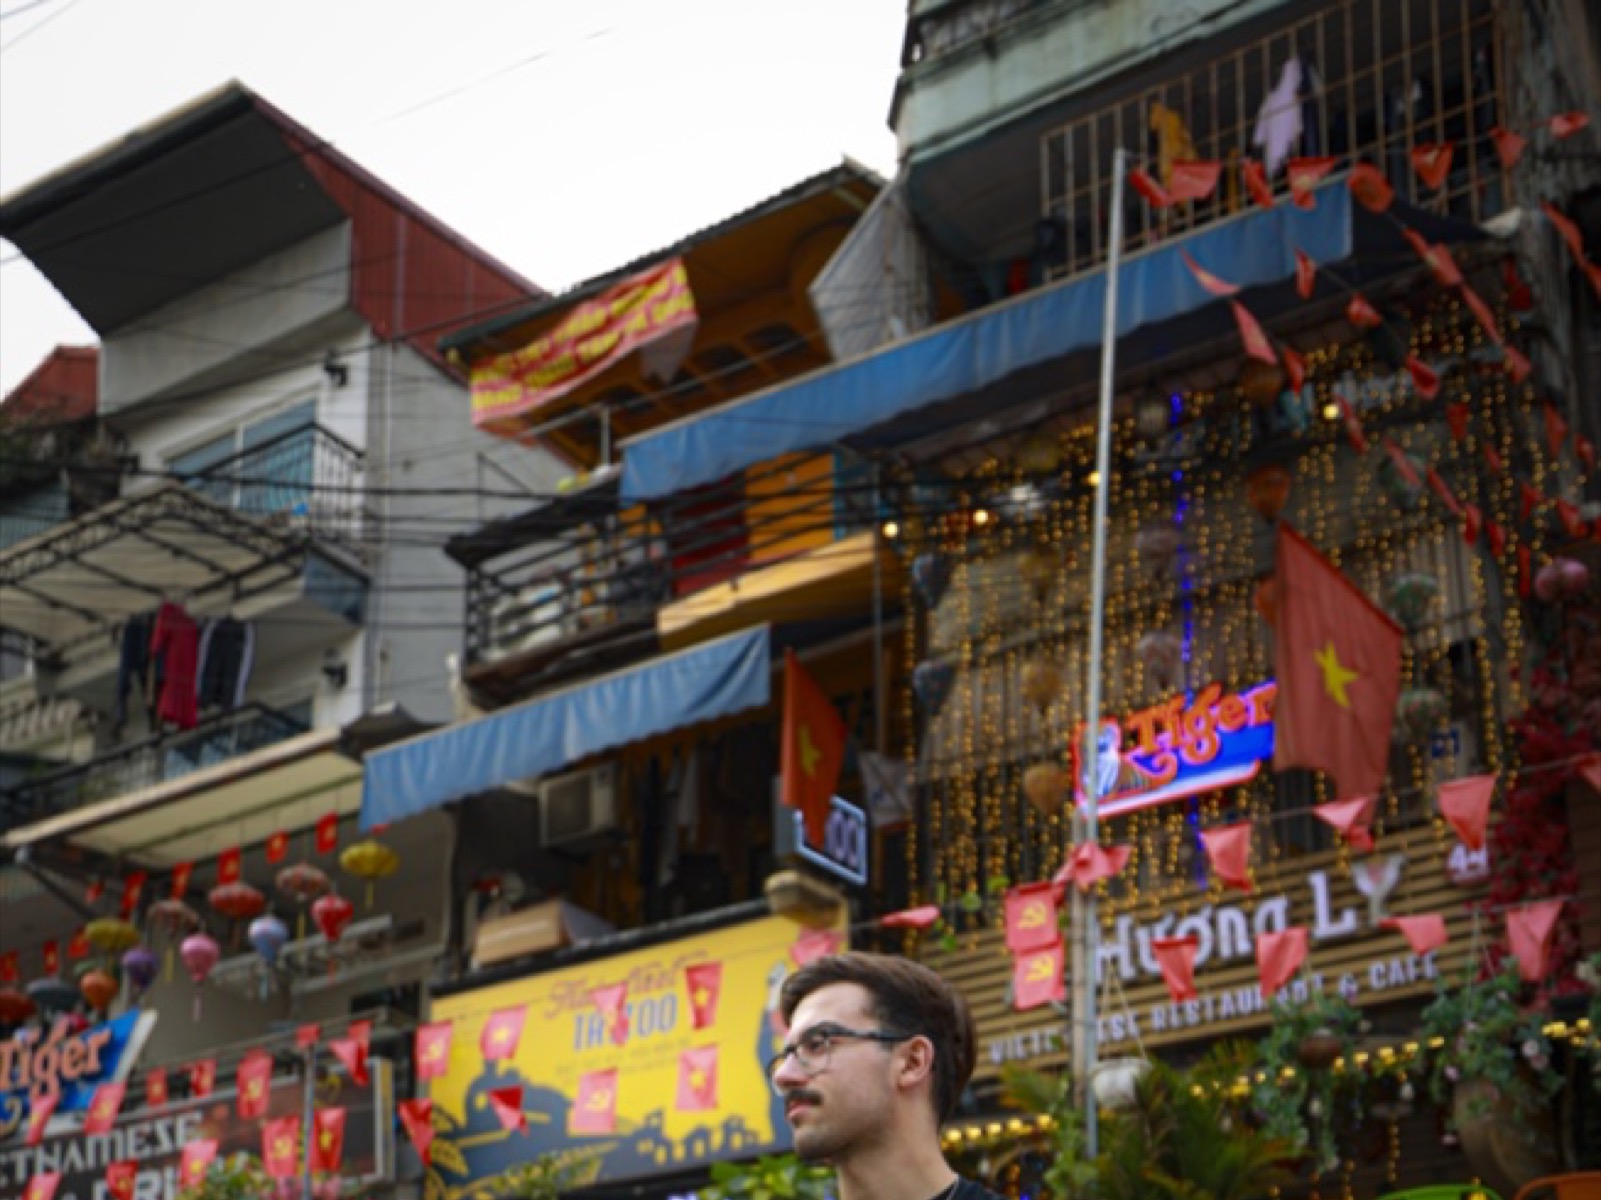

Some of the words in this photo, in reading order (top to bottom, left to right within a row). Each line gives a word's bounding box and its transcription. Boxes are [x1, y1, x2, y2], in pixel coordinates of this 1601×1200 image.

[1126, 682, 1278, 764] Tiger
[1307, 853, 1406, 939] LY
[0, 1018, 112, 1099] Tiger
[573, 992, 678, 1052] TAOO
[989, 1011, 1140, 1063] VIETESE
[0, 1111, 204, 1187] TNAMESE
